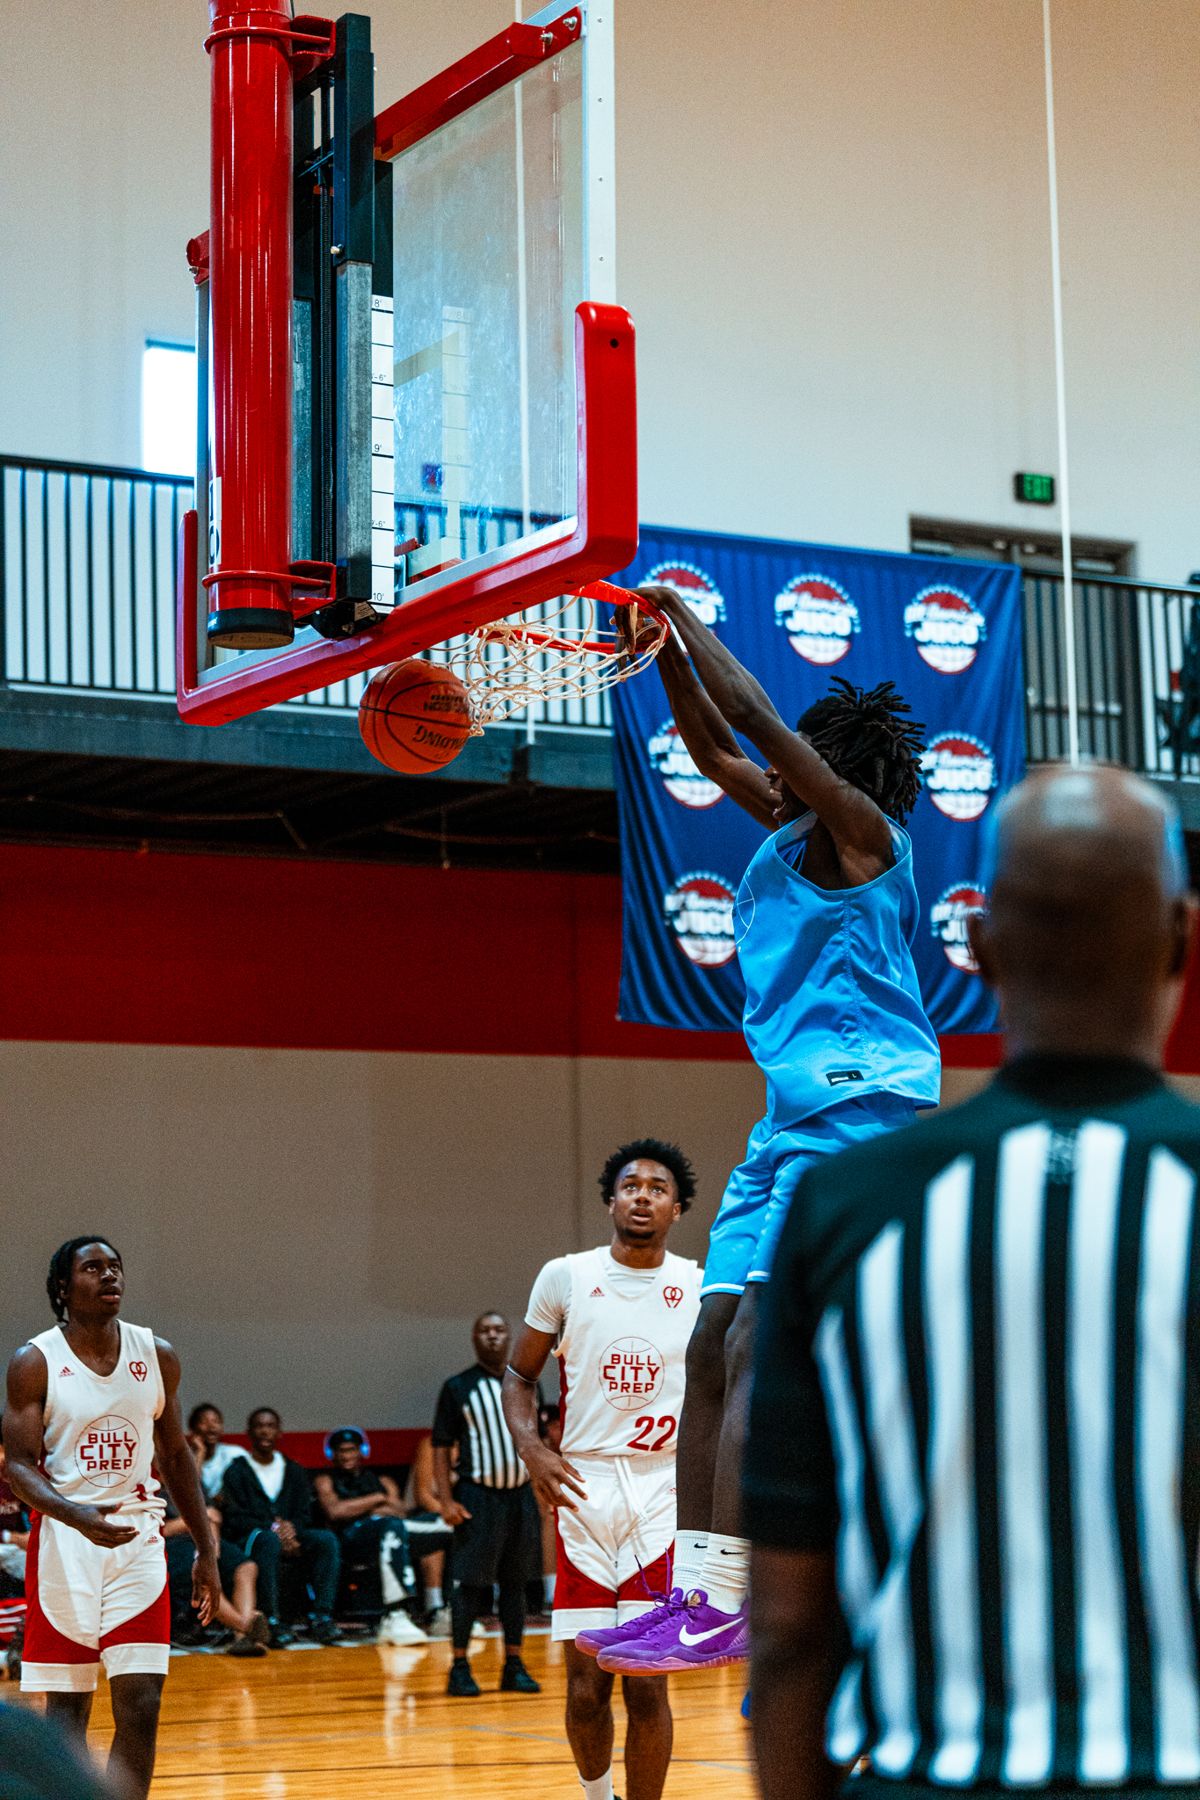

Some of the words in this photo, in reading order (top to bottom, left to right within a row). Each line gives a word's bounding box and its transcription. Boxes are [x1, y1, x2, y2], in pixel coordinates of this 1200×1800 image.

[611, 1354, 656, 1366] BULL
[603, 1365, 660, 1381] CITY
[609, 1382, 654, 1393] PREP
[88, 1431, 133, 1443] BULL
[627, 1415, 676, 1451] 22
[80, 1442, 137, 1460] CITY
[87, 1459, 132, 1471] PREP
